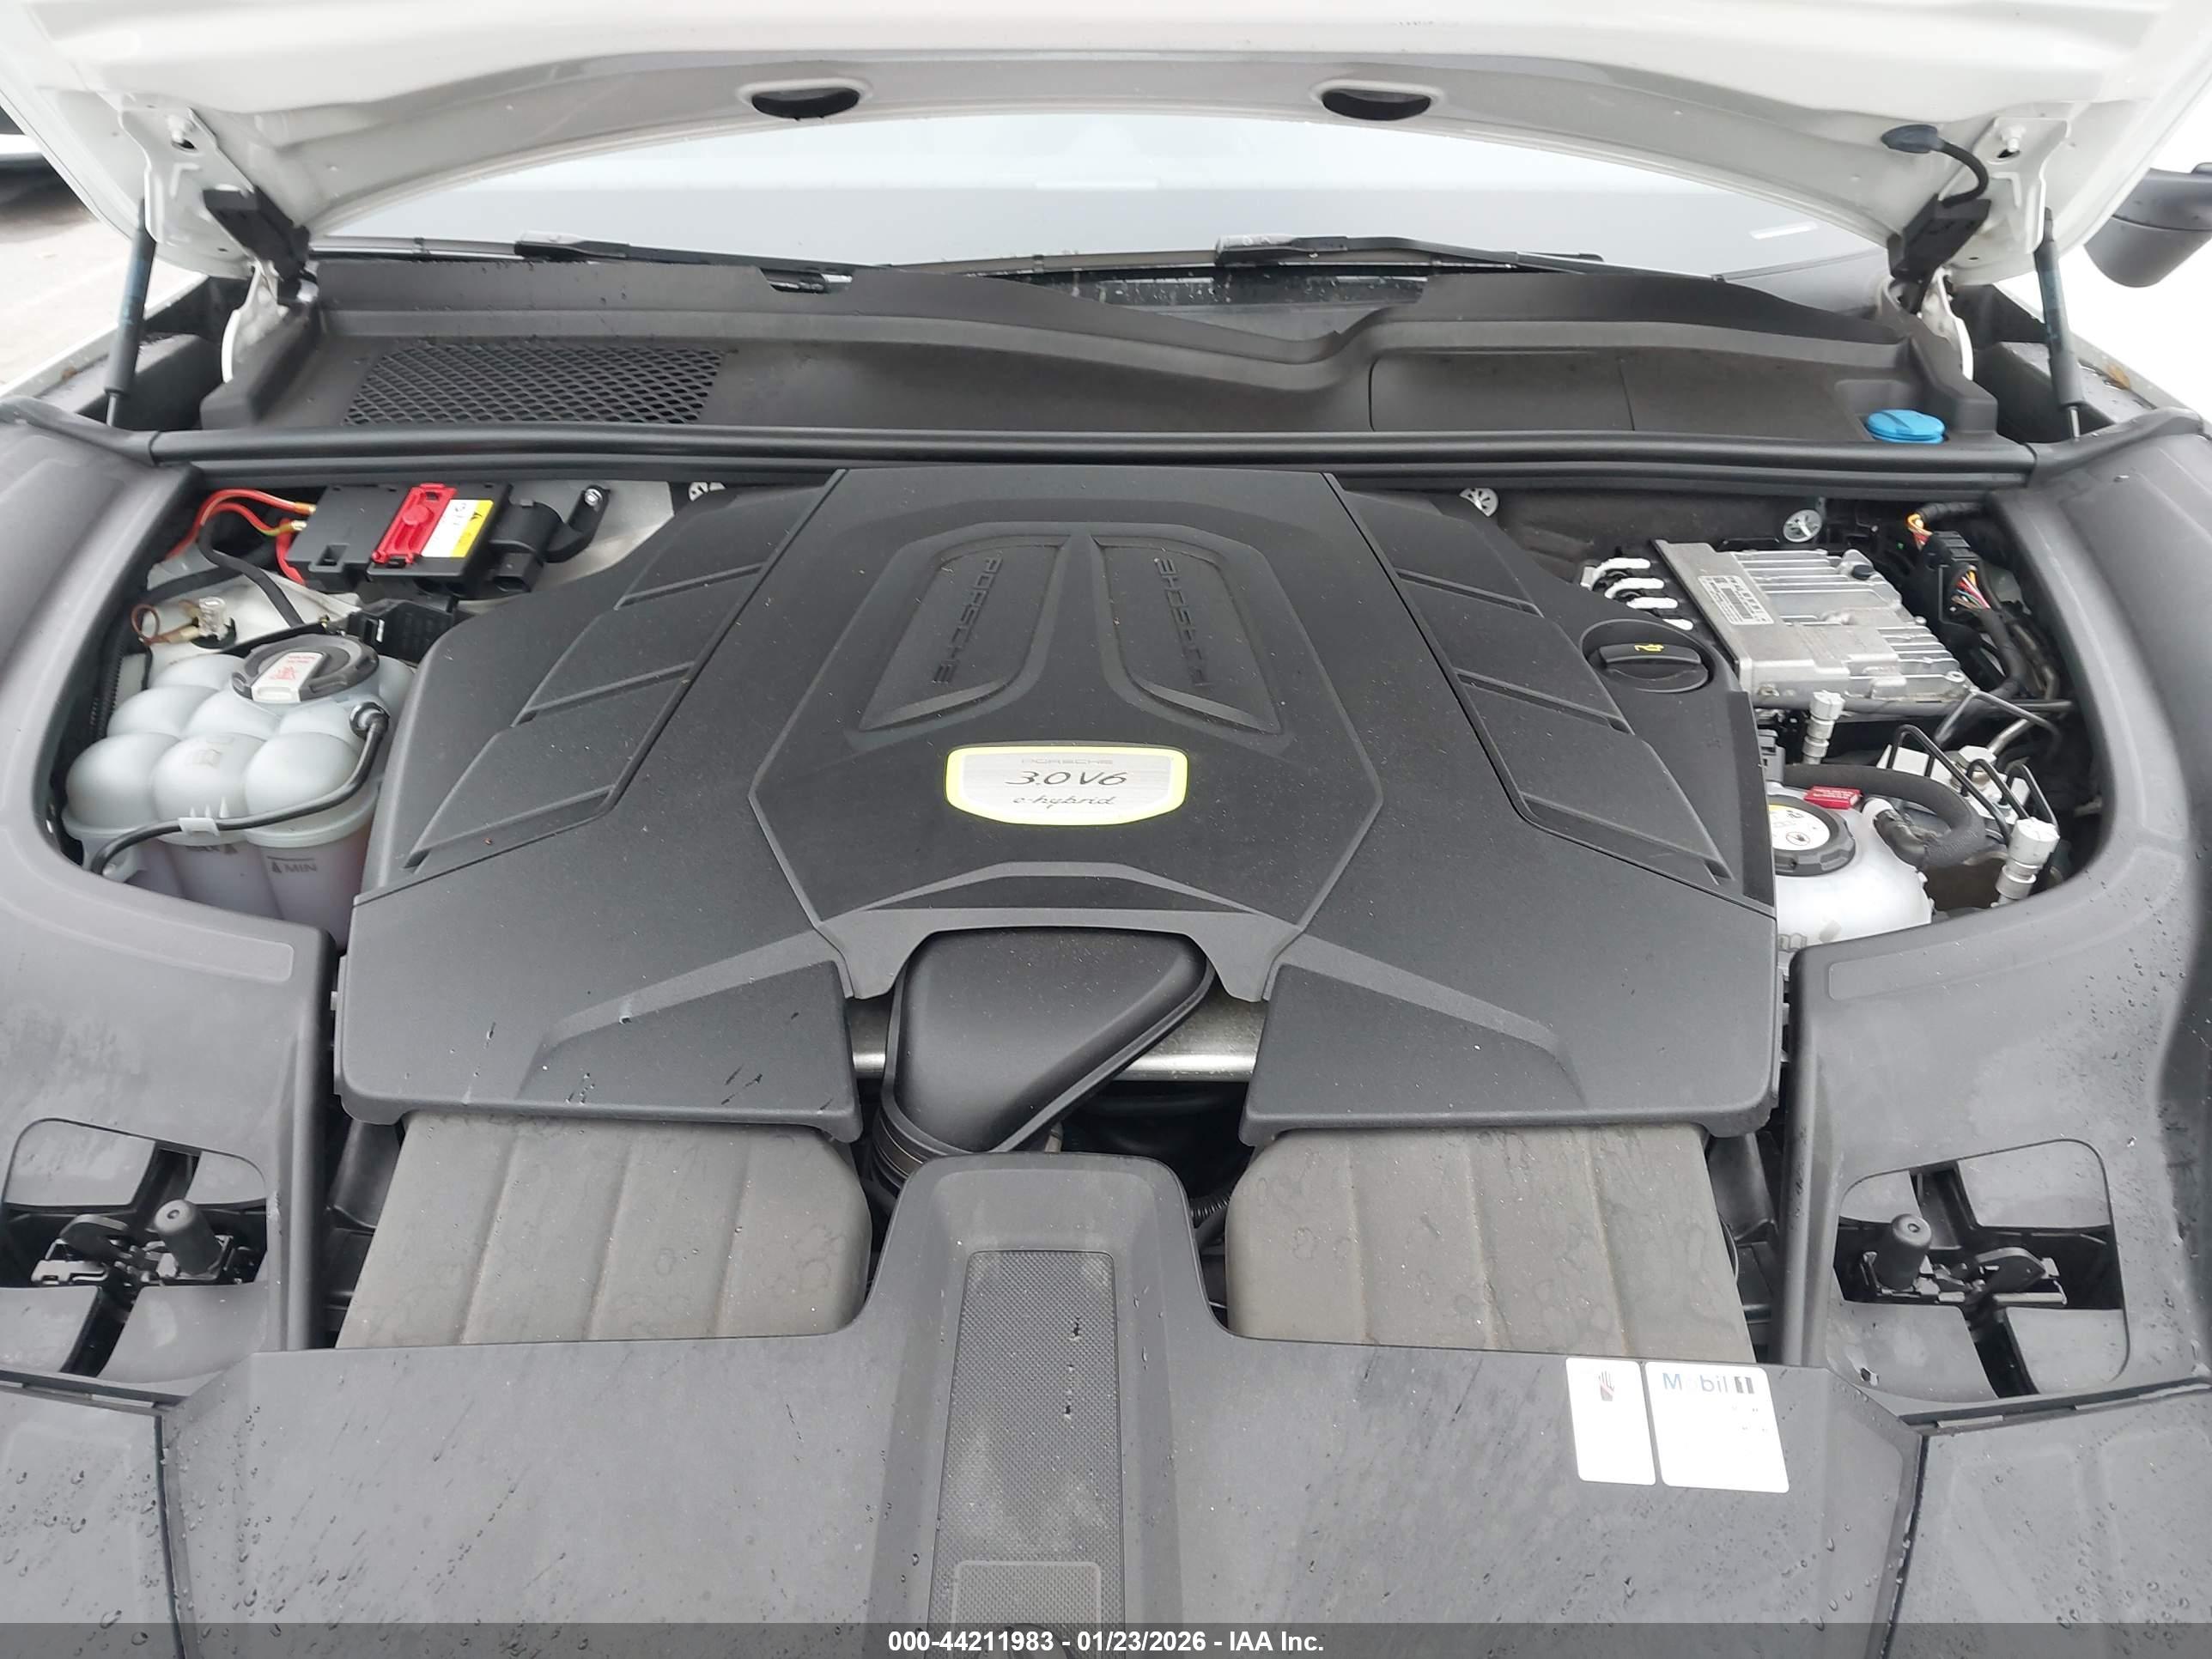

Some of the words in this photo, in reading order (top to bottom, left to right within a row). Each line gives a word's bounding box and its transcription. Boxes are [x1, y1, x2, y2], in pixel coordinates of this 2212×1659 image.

[932, 557, 1003, 684] PORSCHE
[1155, 558, 1208, 685] PORSCHE
[1005, 771, 1072, 786] 3.0
[1079, 771, 1128, 786] V6
[1012, 794, 1116, 809] e-hybrid
[284, 862, 318, 873] MIN
[1662, 1372, 1729, 1394] Mbil
